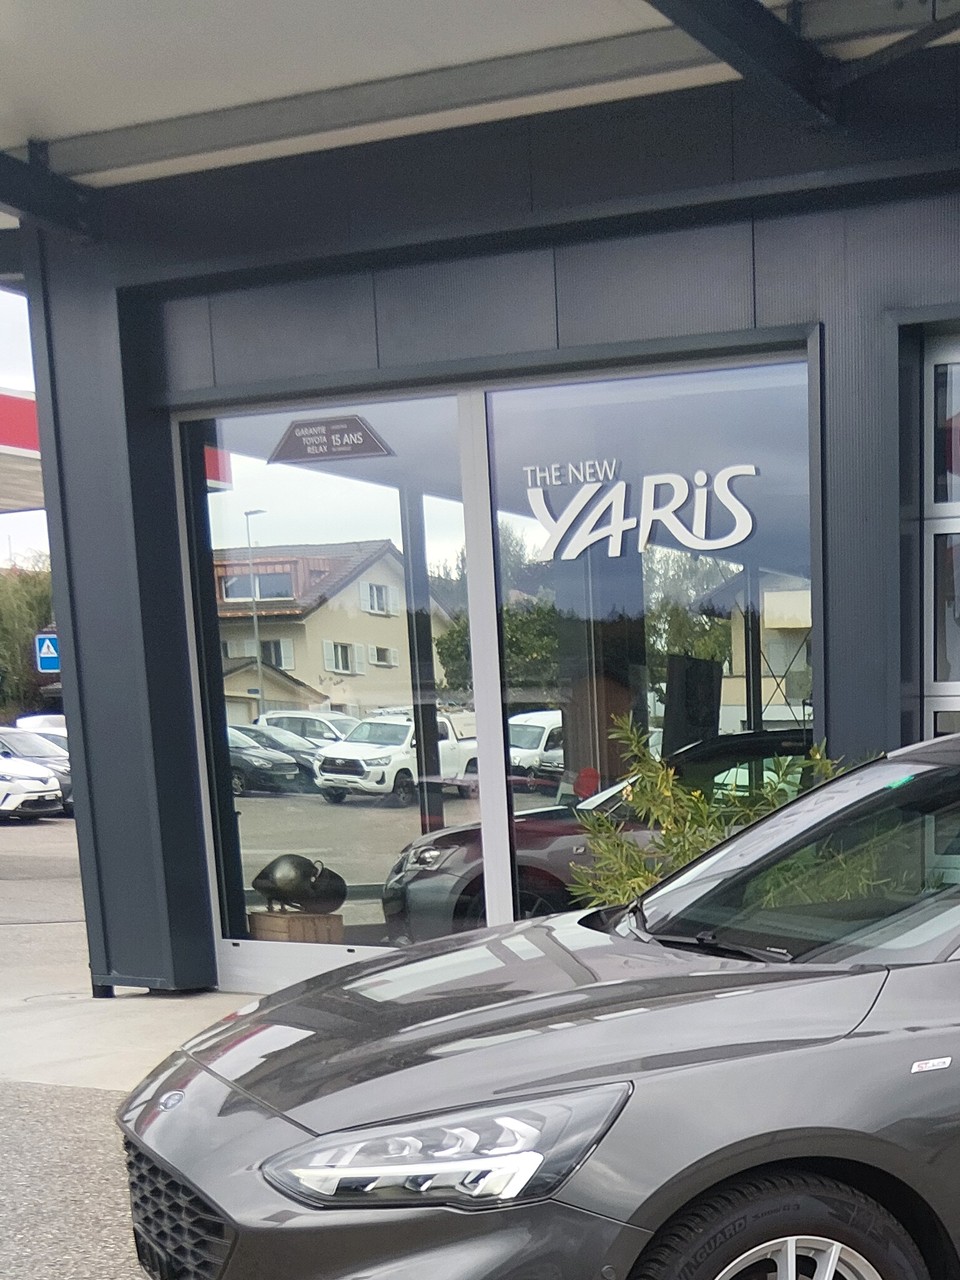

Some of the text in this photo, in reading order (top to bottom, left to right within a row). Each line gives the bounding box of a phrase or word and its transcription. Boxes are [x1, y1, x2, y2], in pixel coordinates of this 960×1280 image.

[295, 426, 327, 437] GARANTIE
[302, 436, 327, 445] TOYOTA
[331, 432, 364, 446] 15 ANS
[307, 445, 328, 454] RELAX
[522, 458, 617, 488] THE NEW
